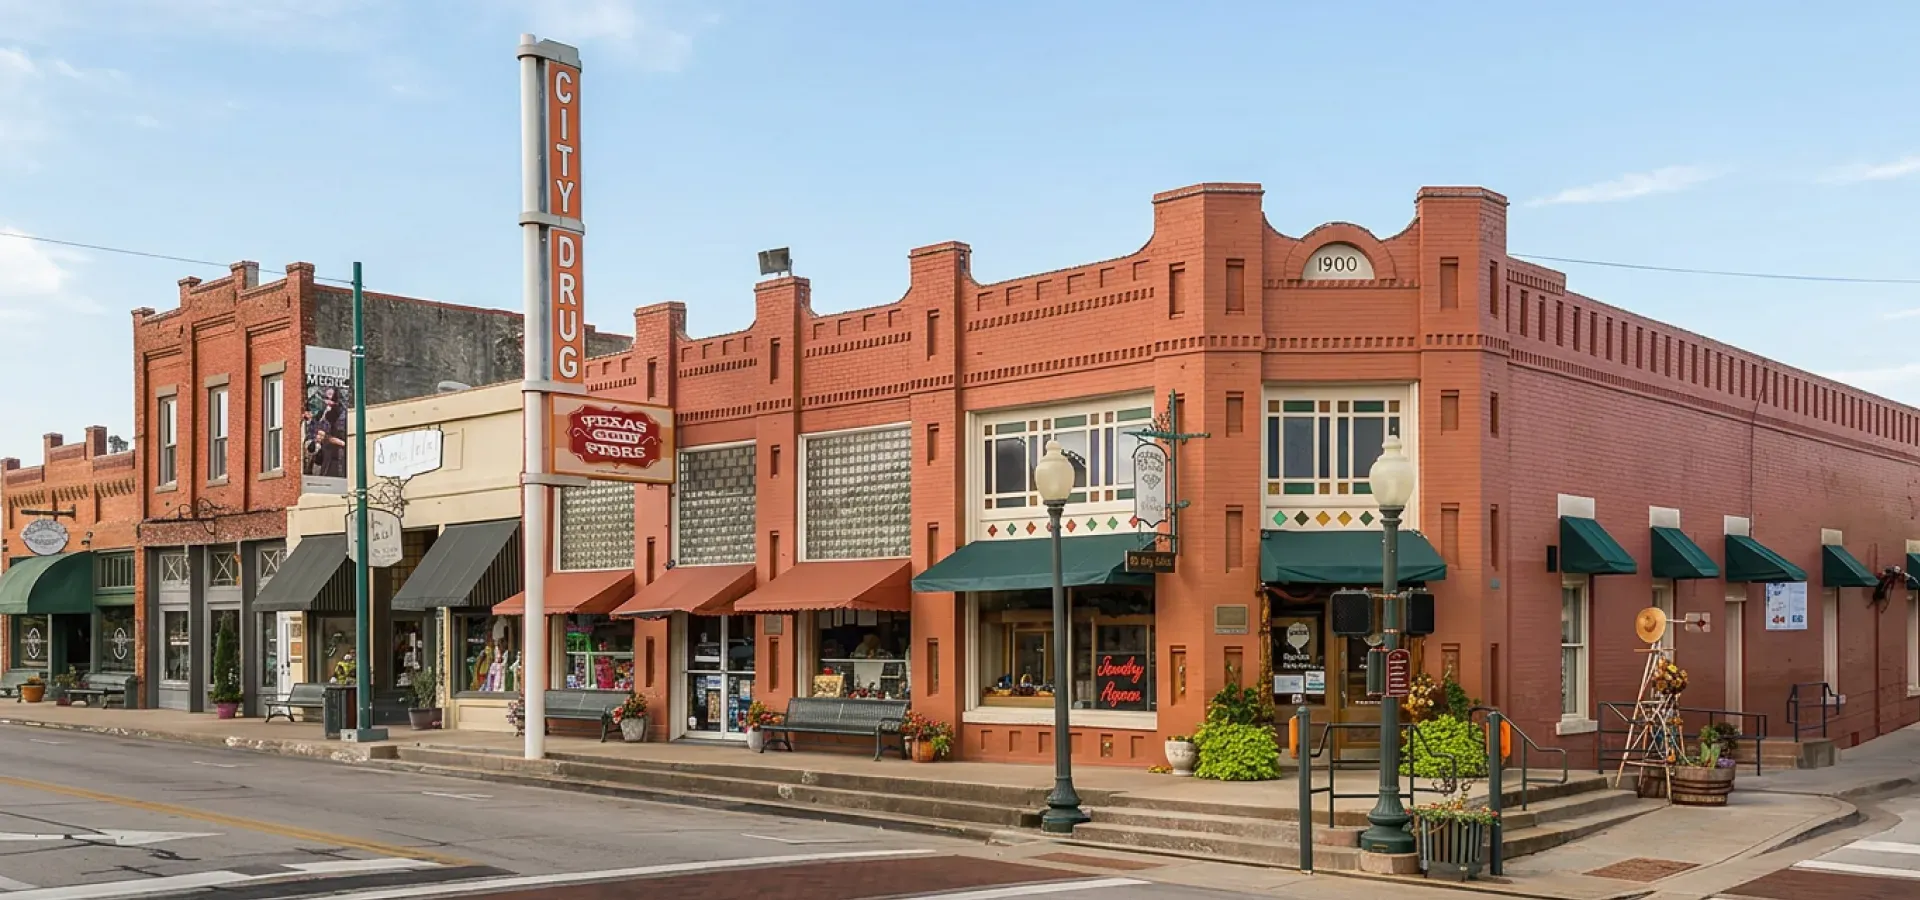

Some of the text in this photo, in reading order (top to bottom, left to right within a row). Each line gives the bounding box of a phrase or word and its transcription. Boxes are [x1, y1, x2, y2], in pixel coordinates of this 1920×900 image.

[555, 71, 578, 379] CITY DRUG
[1318, 256, 1358, 272] 1900
